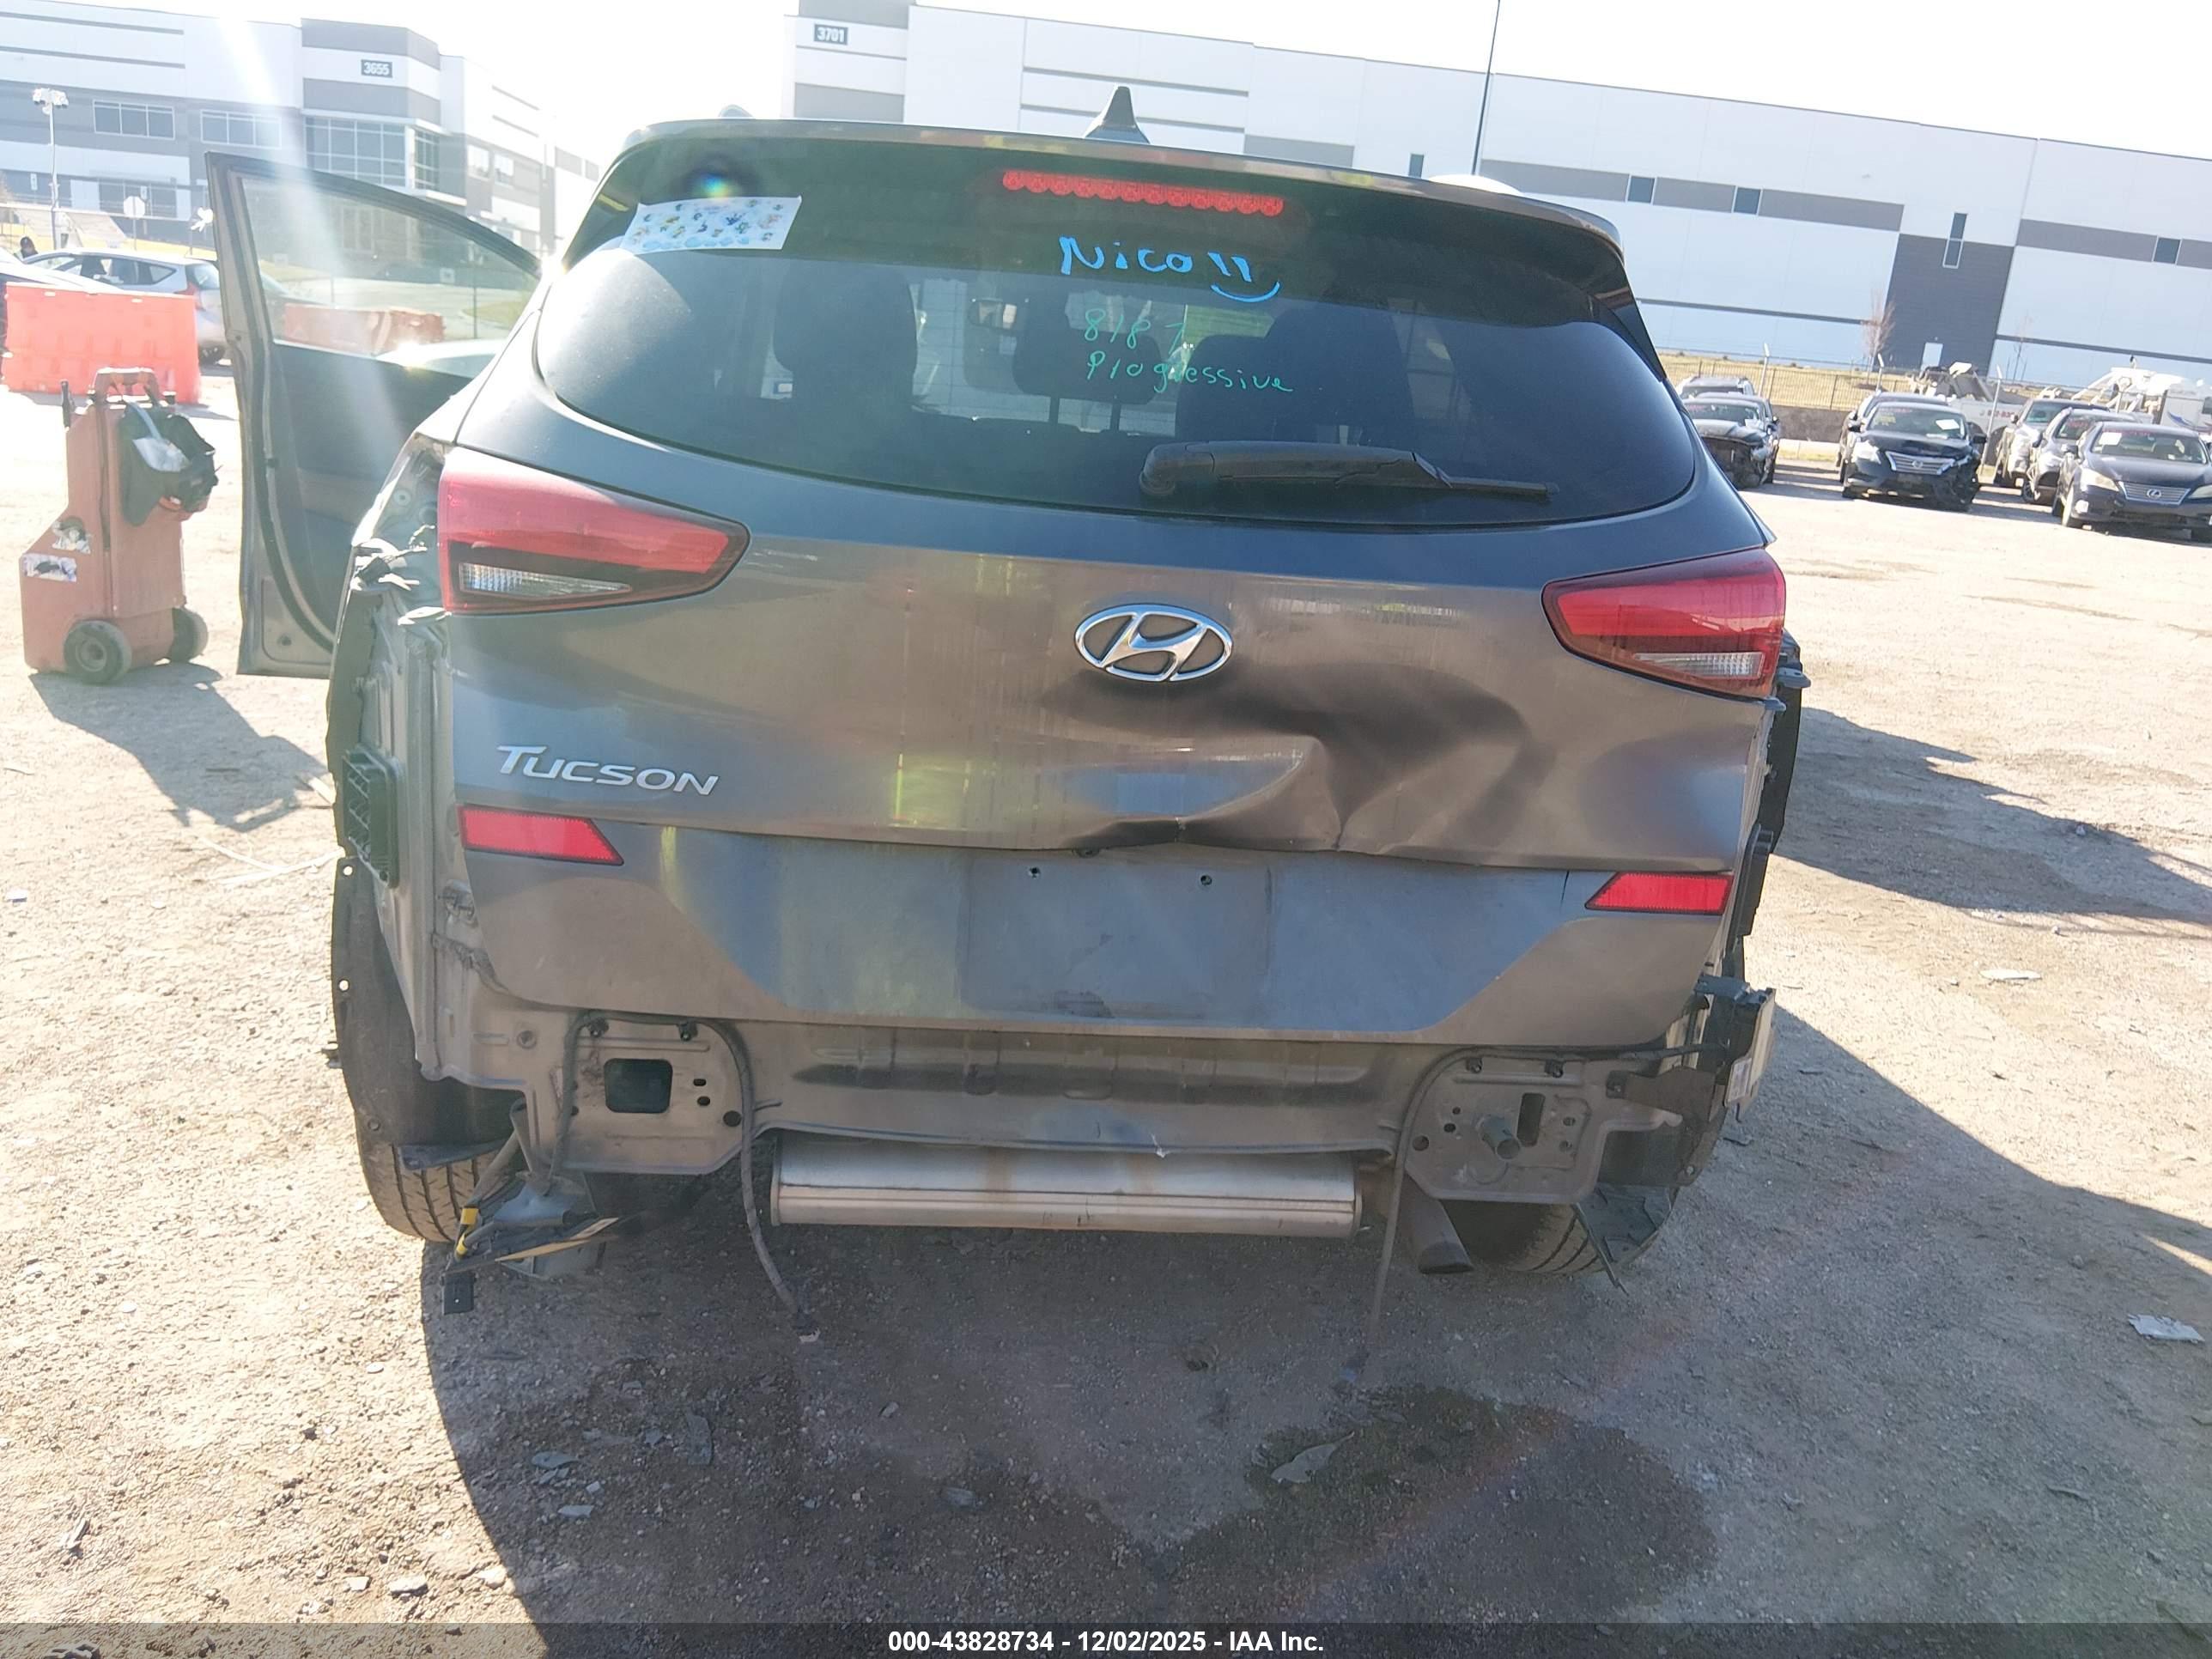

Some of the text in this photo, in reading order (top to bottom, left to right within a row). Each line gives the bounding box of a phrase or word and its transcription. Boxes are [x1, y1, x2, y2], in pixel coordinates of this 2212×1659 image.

[817, 27, 845, 43] 3701
[363, 61, 390, 76] 3655
[496, 745, 720, 796] TUCSON
